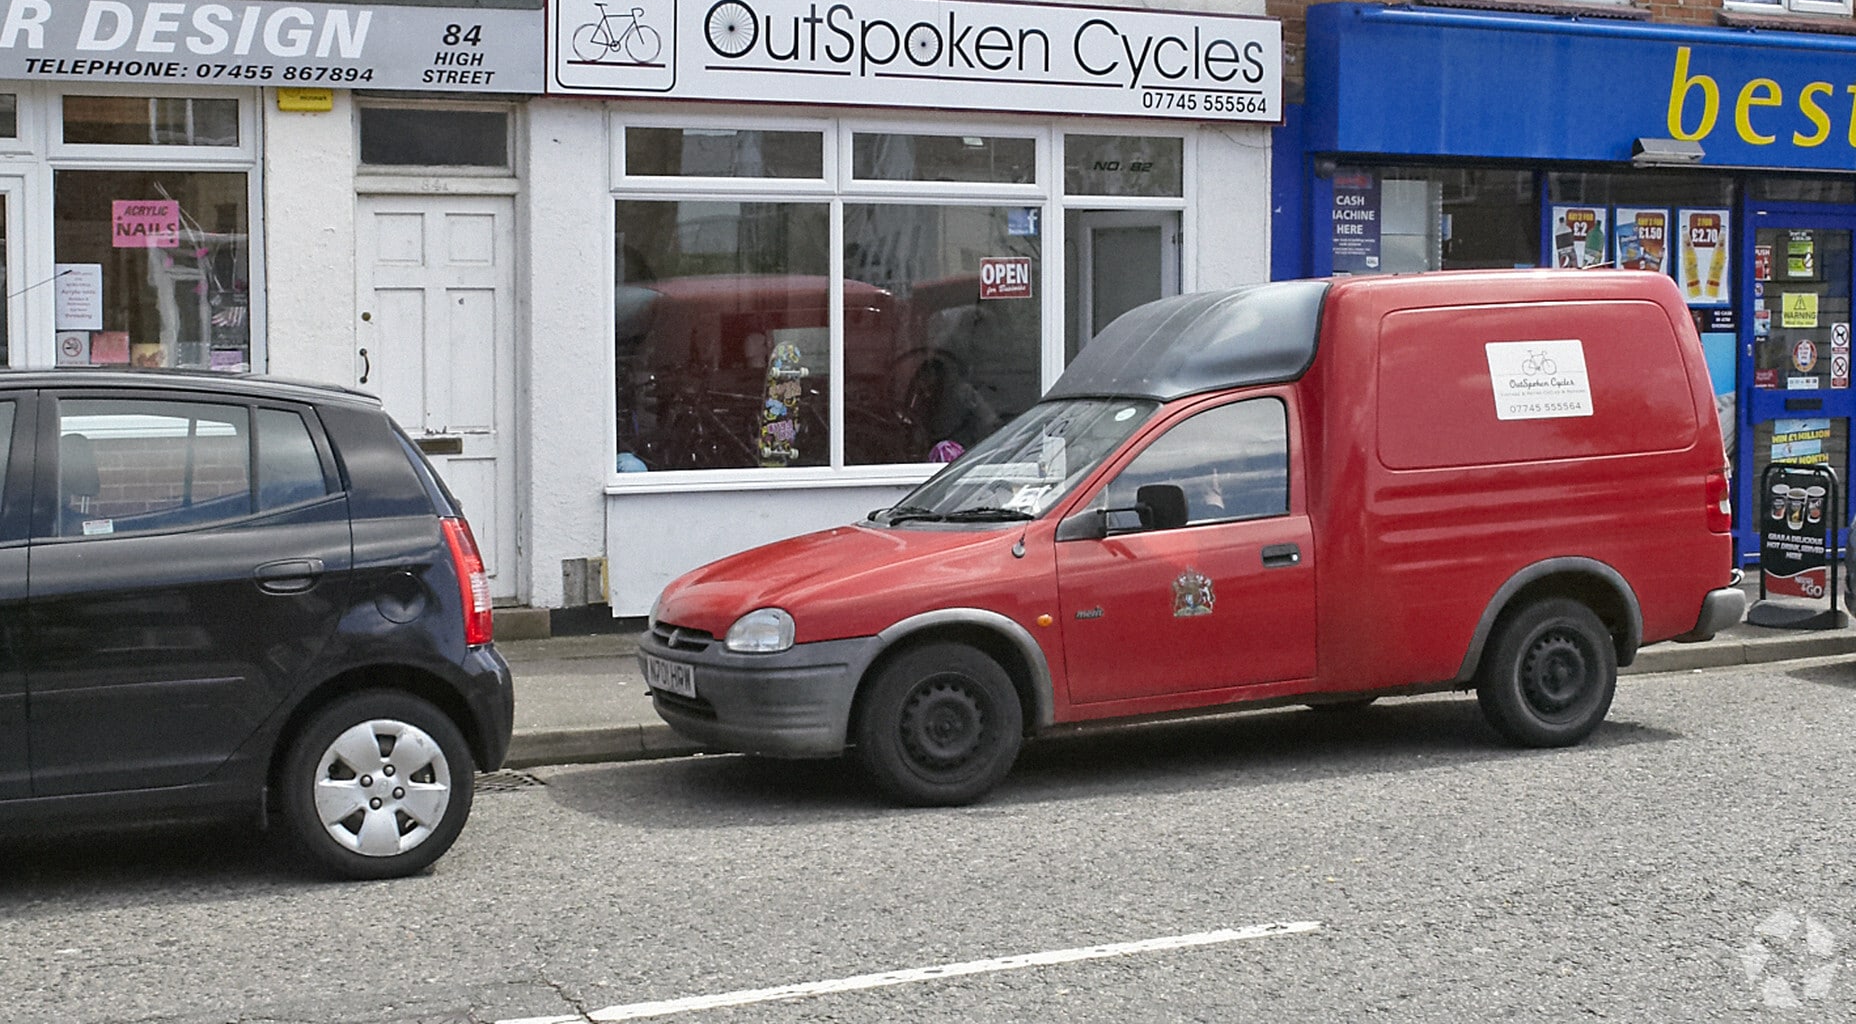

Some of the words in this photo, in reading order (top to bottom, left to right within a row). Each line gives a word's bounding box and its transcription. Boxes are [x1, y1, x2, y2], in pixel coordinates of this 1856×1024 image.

[76, 0, 373, 59] DESIGN
[443, 24, 482, 46] 84
[434, 52, 484, 66] HIGH
[1074, 19, 1264, 89] Cycles
[25, 58, 188, 77] TELEPHONE:
[196, 64, 274, 79] 07455
[283, 66, 374, 82] 867894
[422, 69, 496, 85] STREET
[1142, 91, 1197, 110] 07745
[1203, 95, 1267, 114] 555564
[1093, 161, 1124, 172] NO.
[1130, 162, 1153, 172] 82
[1336, 195, 1365, 206] CASH
[124, 205, 169, 216] ACRYLIC
[116, 222, 176, 236] NAILS
[1336, 224, 1363, 235] HERE
[1573, 222, 1588, 236] £2
[1638, 227, 1662, 240] £1.50
[1691, 228, 1718, 243] £2.70
[982, 263, 1029, 285] OPEN
[1784, 311, 1816, 320] WARNING
[1510, 403, 1541, 413] 07745
[1544, 401, 1581, 412] 555564
